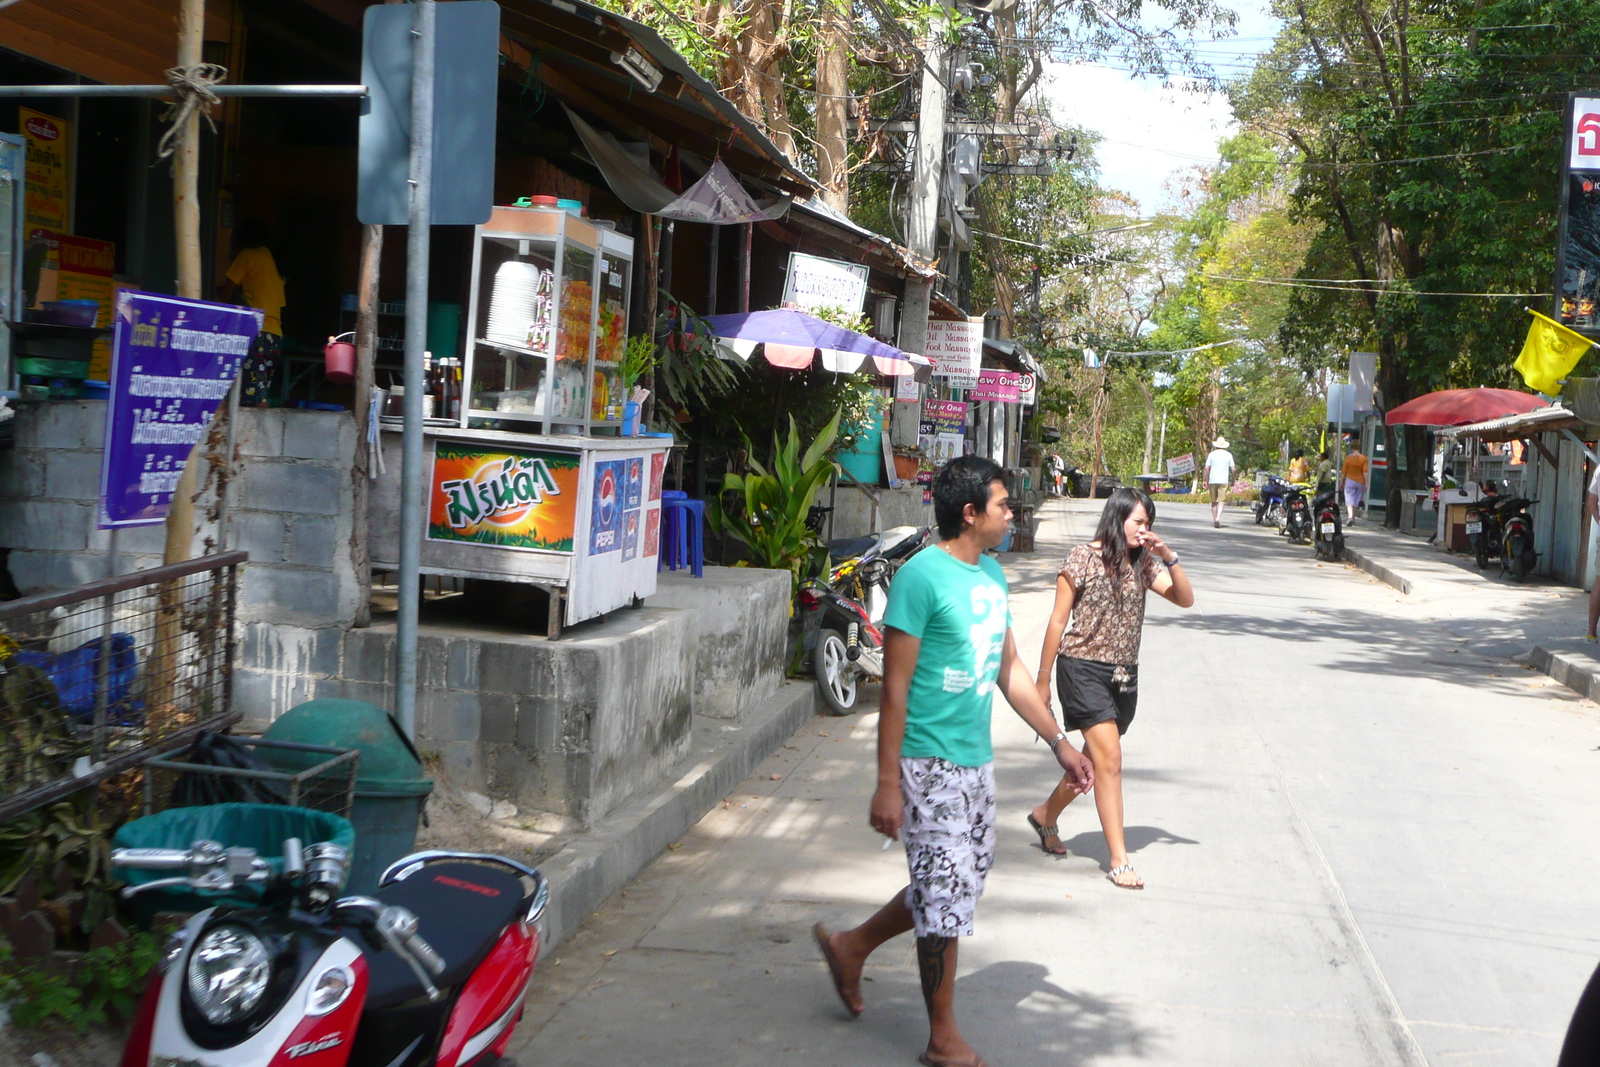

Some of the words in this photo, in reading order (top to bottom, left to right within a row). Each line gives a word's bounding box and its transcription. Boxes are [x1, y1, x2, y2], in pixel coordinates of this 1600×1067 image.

[927, 322, 942, 331] Thai
[979, 376, 996, 385] ew
[999, 376, 1019, 386] One
[1019, 376, 1030, 385] 30
[947, 403, 963, 412] One
[596, 530, 615, 548] PEPSI
